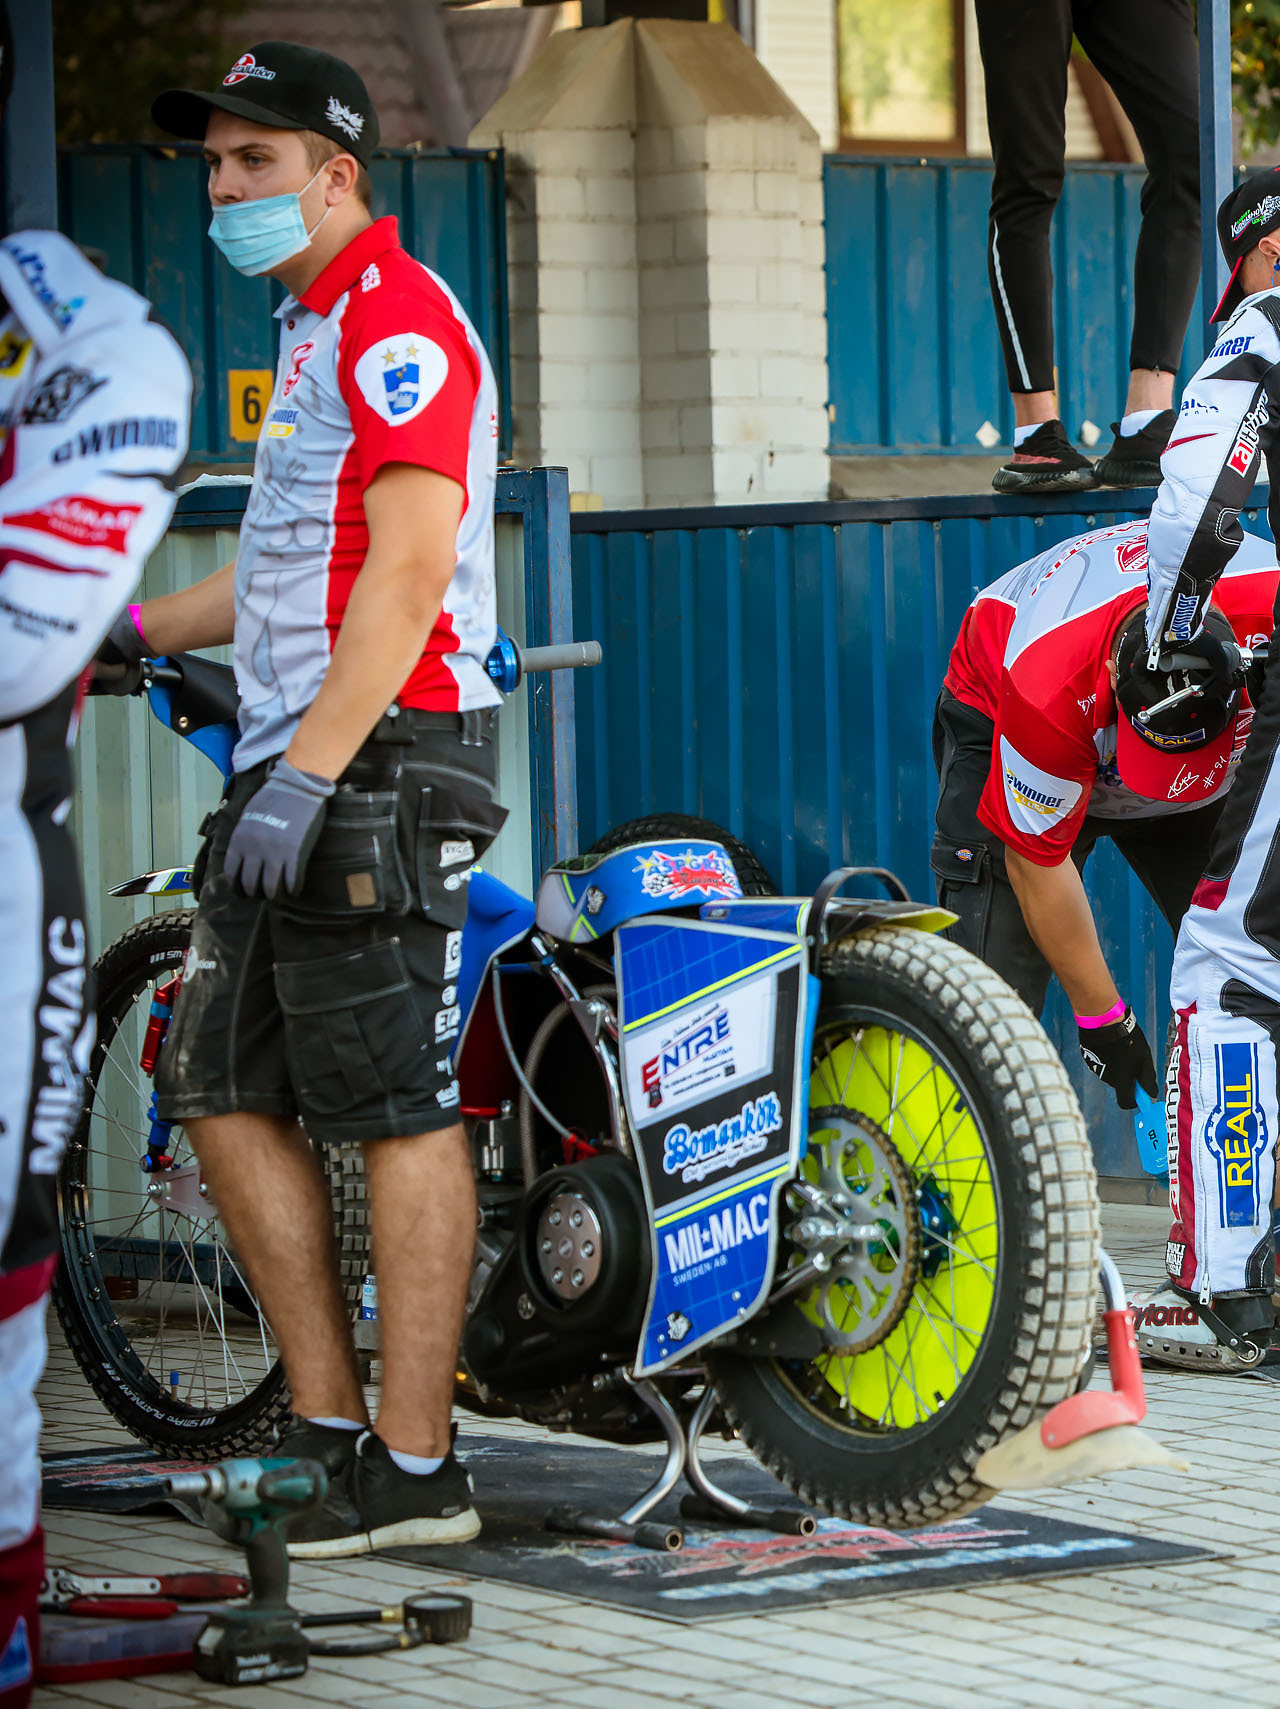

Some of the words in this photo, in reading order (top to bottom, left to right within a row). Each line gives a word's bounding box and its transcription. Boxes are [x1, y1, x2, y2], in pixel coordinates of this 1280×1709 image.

[242, 385, 261, 425] 6
[1144, 729, 1191, 745] REALL
[1226, 1073, 1252, 1188] REALL
[672, 1263, 712, 1287] SWEDEN
